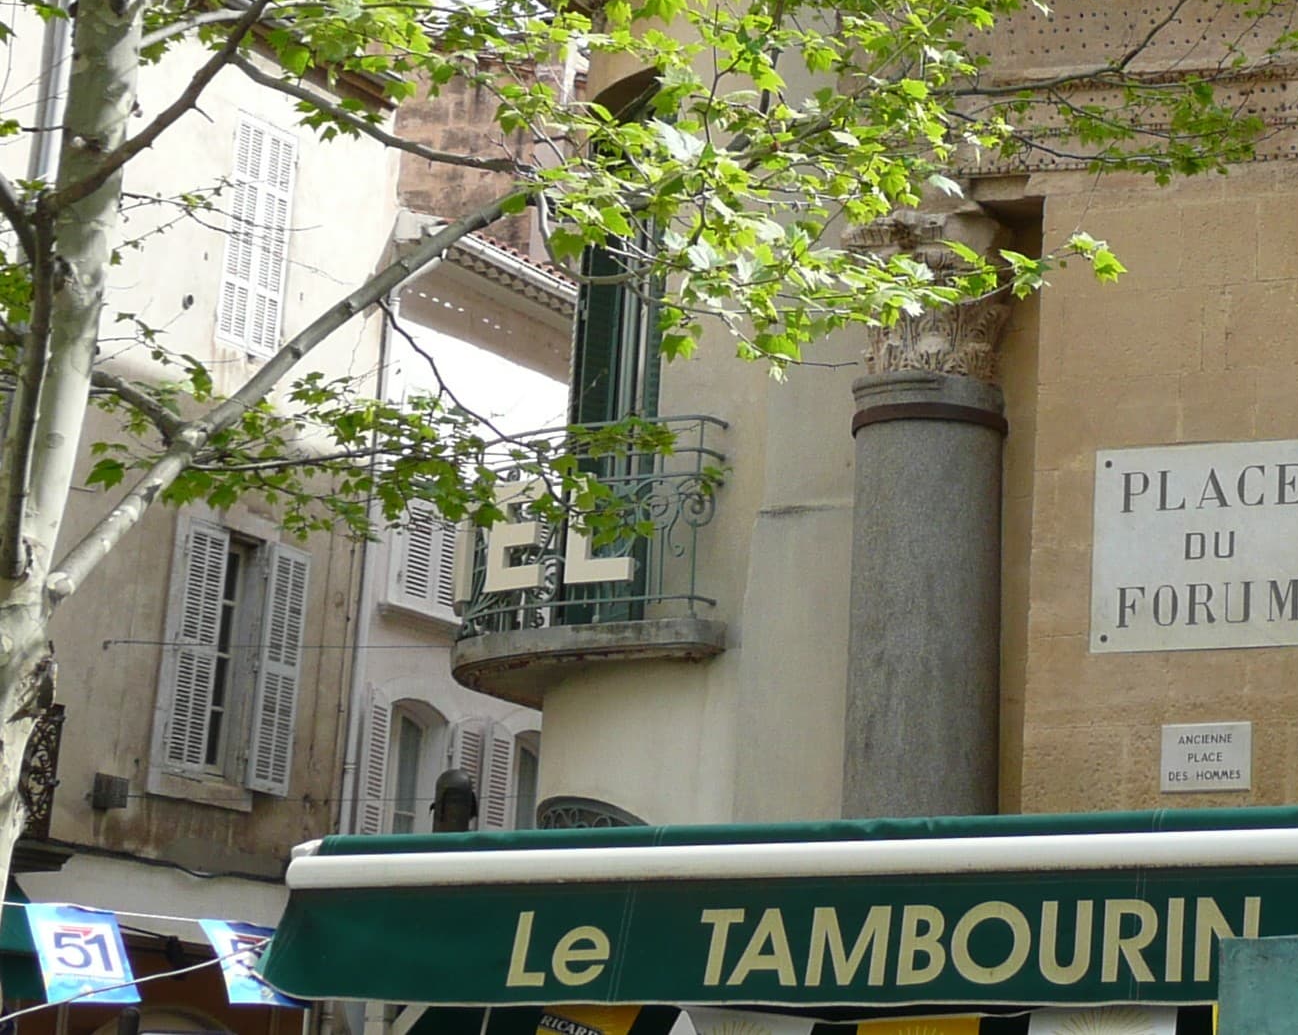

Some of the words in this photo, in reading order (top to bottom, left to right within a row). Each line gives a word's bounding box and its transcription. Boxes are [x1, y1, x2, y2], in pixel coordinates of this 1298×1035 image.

[1184, 530, 1236, 560] DU
[1178, 732, 1233, 746] ANCIENNE
[1187, 751, 1223, 763] PLACE
[1168, 770, 1189, 782] DES
[1196, 768, 1241, 781] HOMMES
[53, 931, 114, 972] 51
[505, 910, 611, 988] Le
[700, 896, 1261, 987] TAMBOURIN
